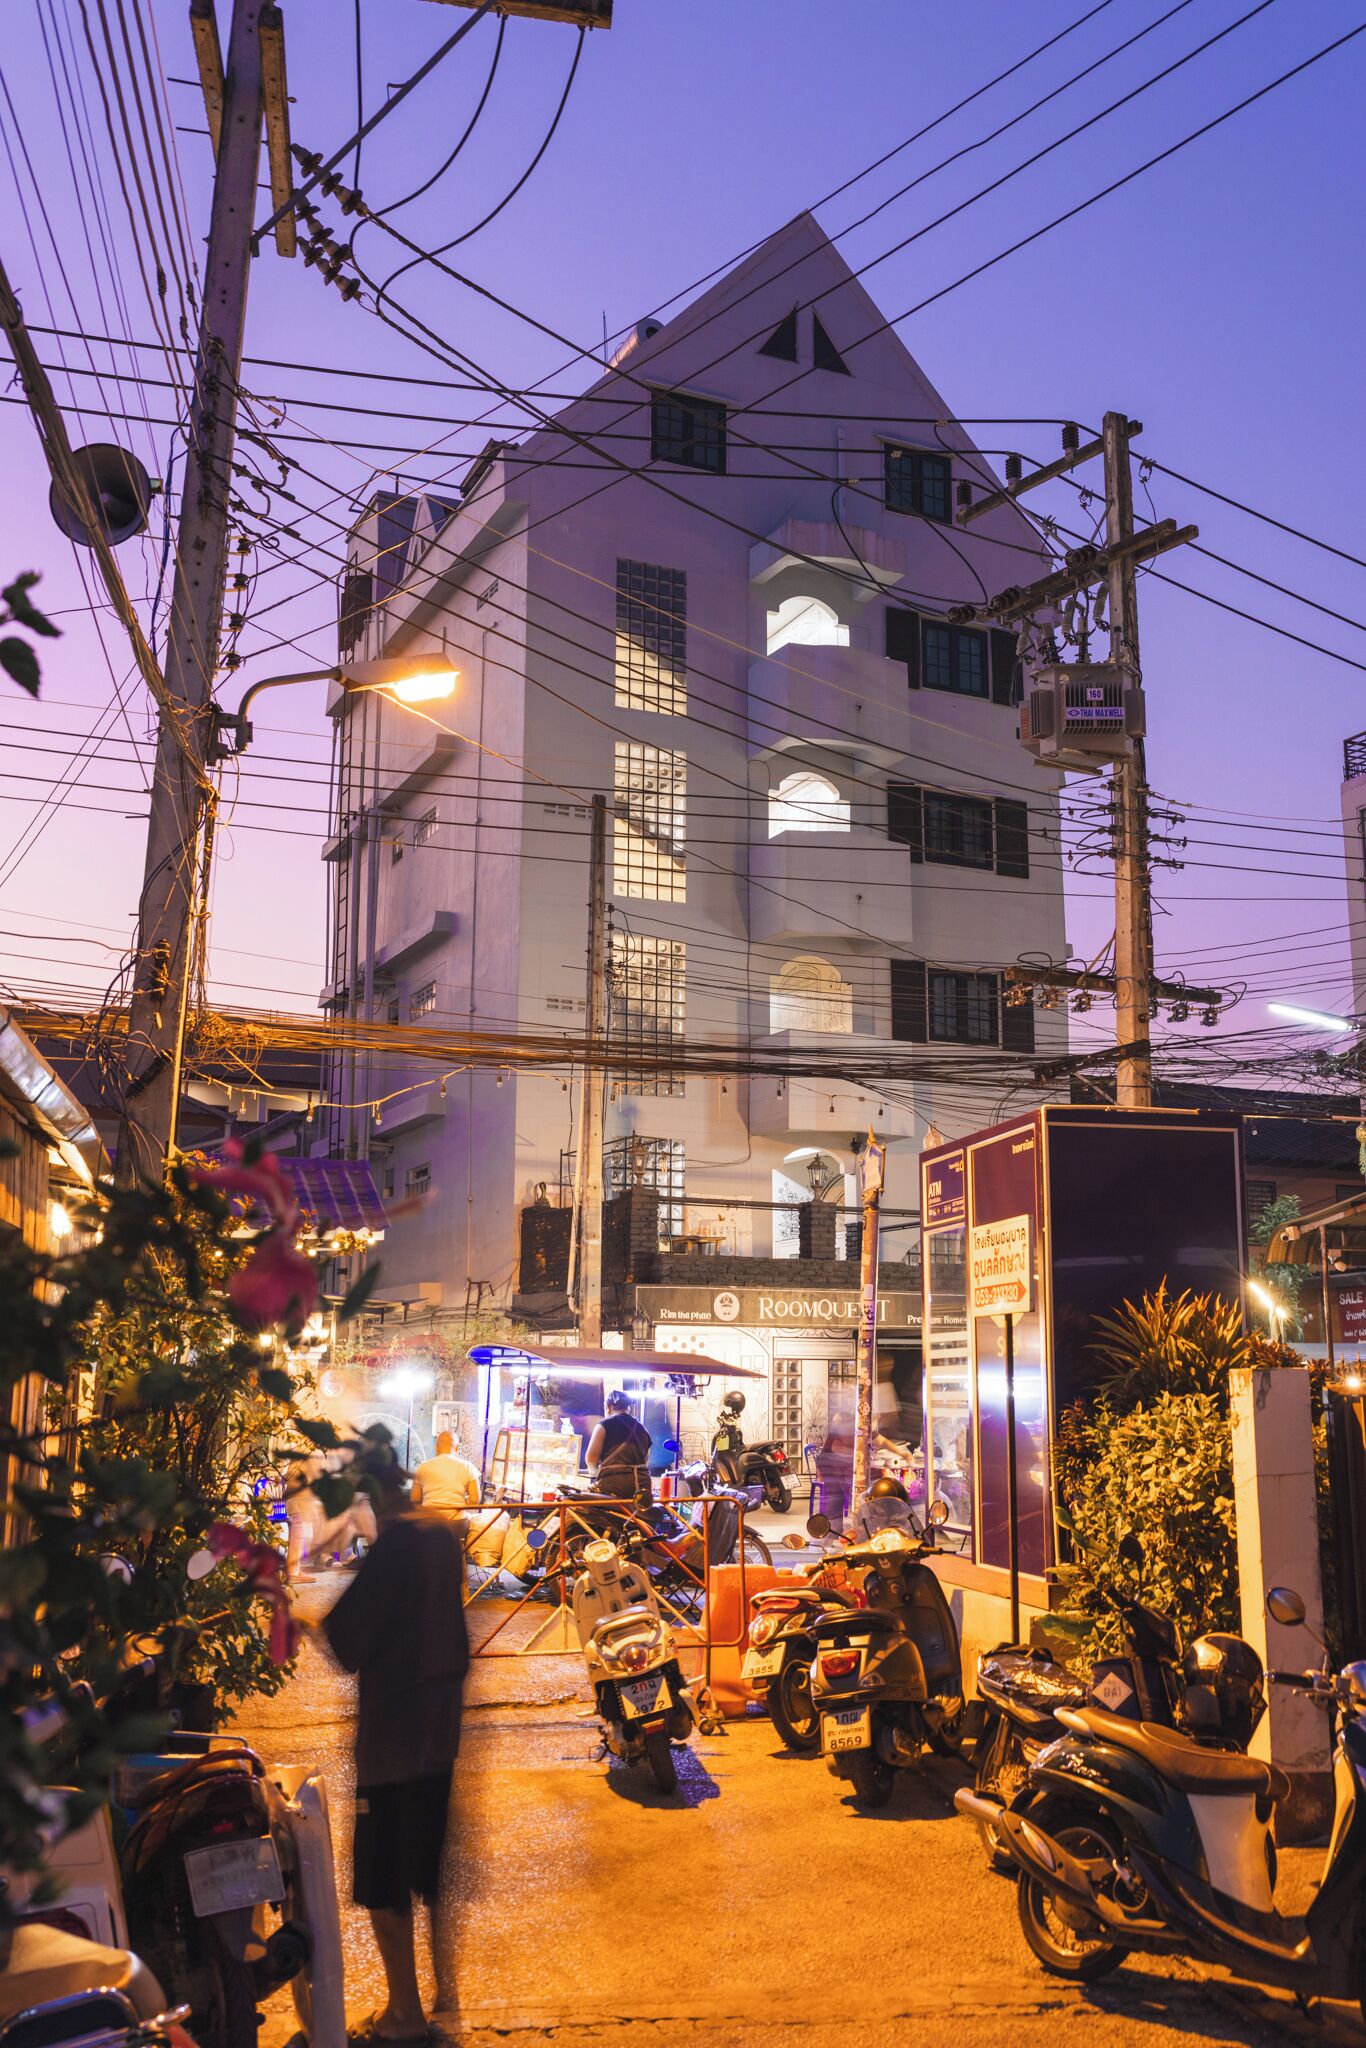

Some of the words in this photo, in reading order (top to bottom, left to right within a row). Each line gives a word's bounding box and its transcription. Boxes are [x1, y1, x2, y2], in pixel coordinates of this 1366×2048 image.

[1089, 690, 1102, 699] 160
[1080, 708, 1094, 717] THAI
[1095, 708, 1124, 718] MAXWELL
[928, 1181, 942, 1198] ATM
[1339, 1291, 1363, 1305] SALE
[759, 1297, 890, 1322] ROOMQUET
[830, 1735, 862, 1750] 8569
